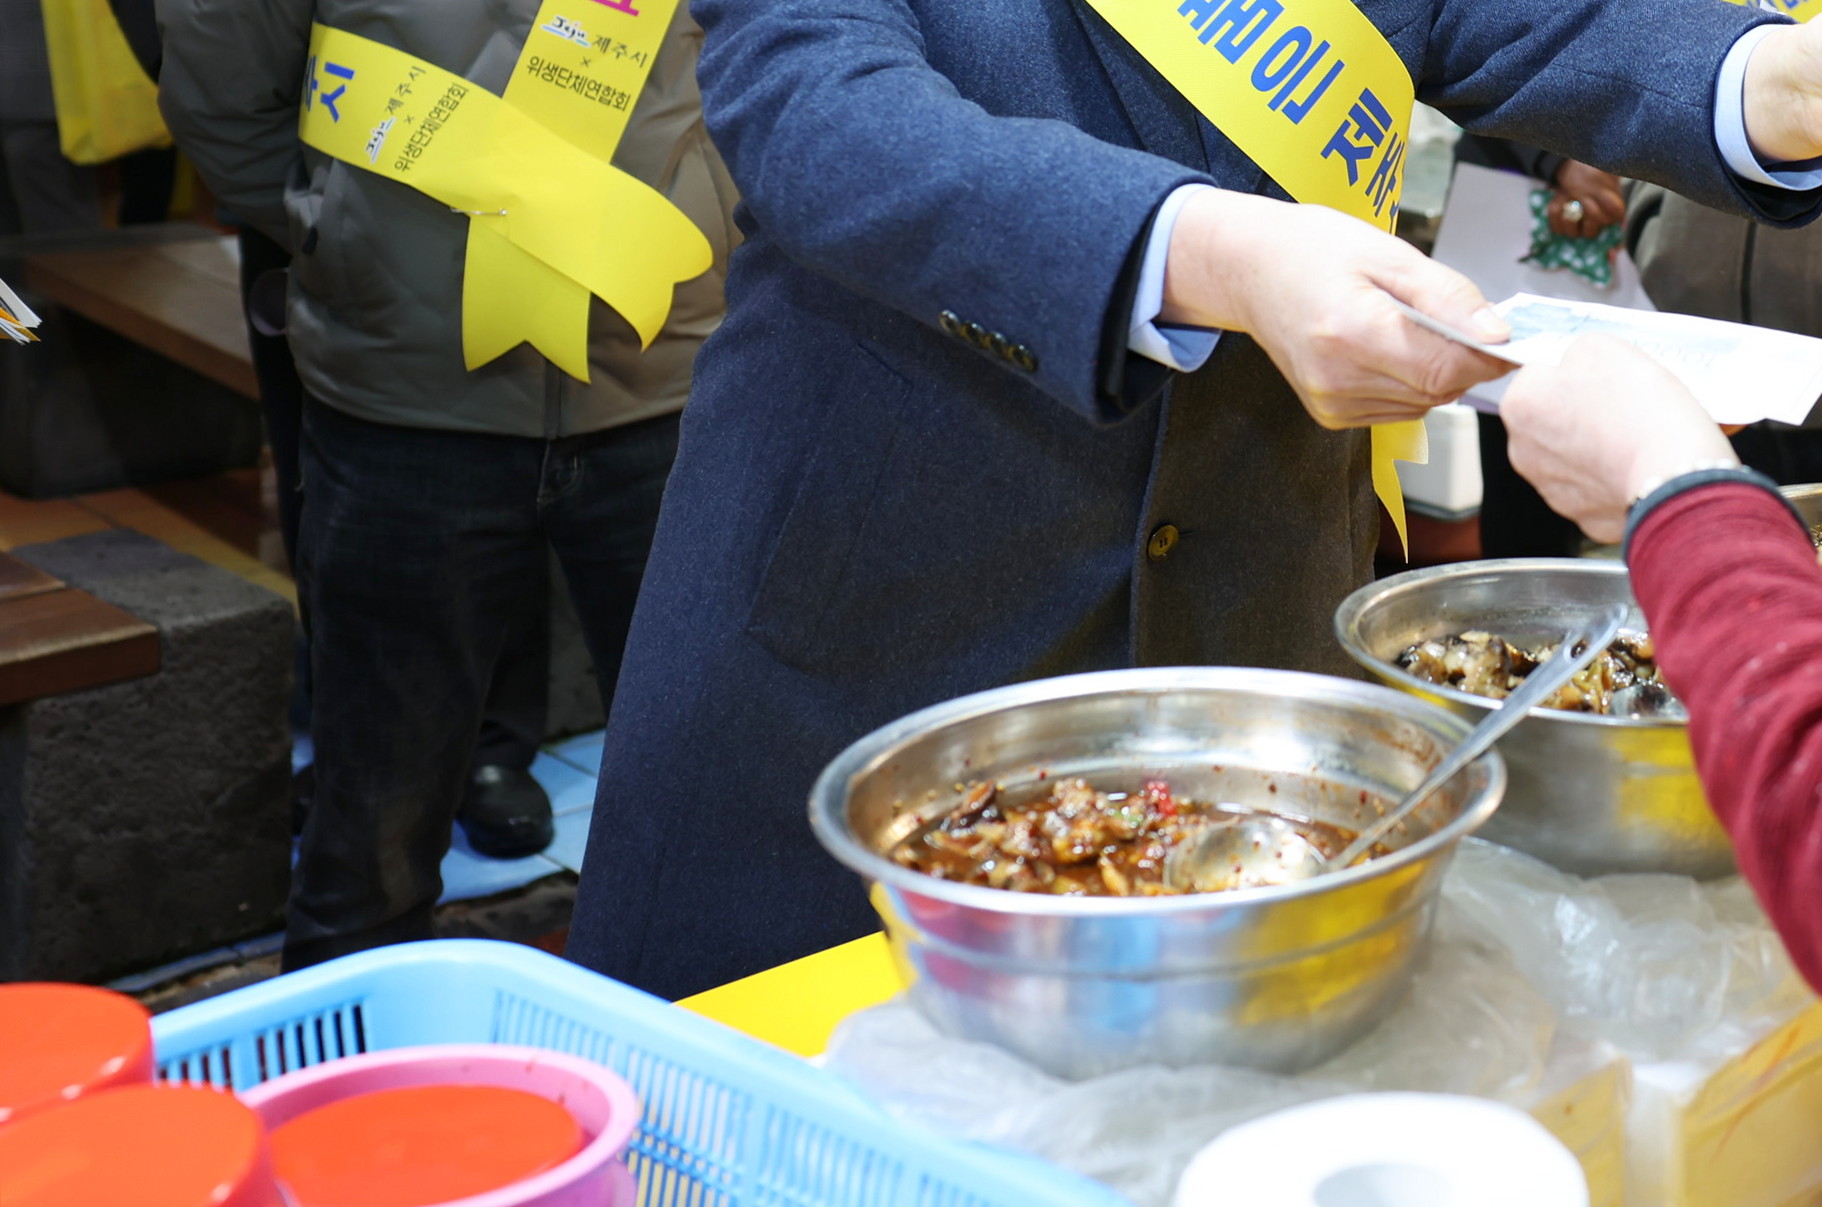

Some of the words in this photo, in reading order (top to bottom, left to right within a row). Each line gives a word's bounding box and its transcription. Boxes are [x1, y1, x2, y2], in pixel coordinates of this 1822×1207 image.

[591, 36, 648, 68] 제주시
[385, 66, 426, 115] 제주시
[527, 56, 631, 111] 위생단체연합회
